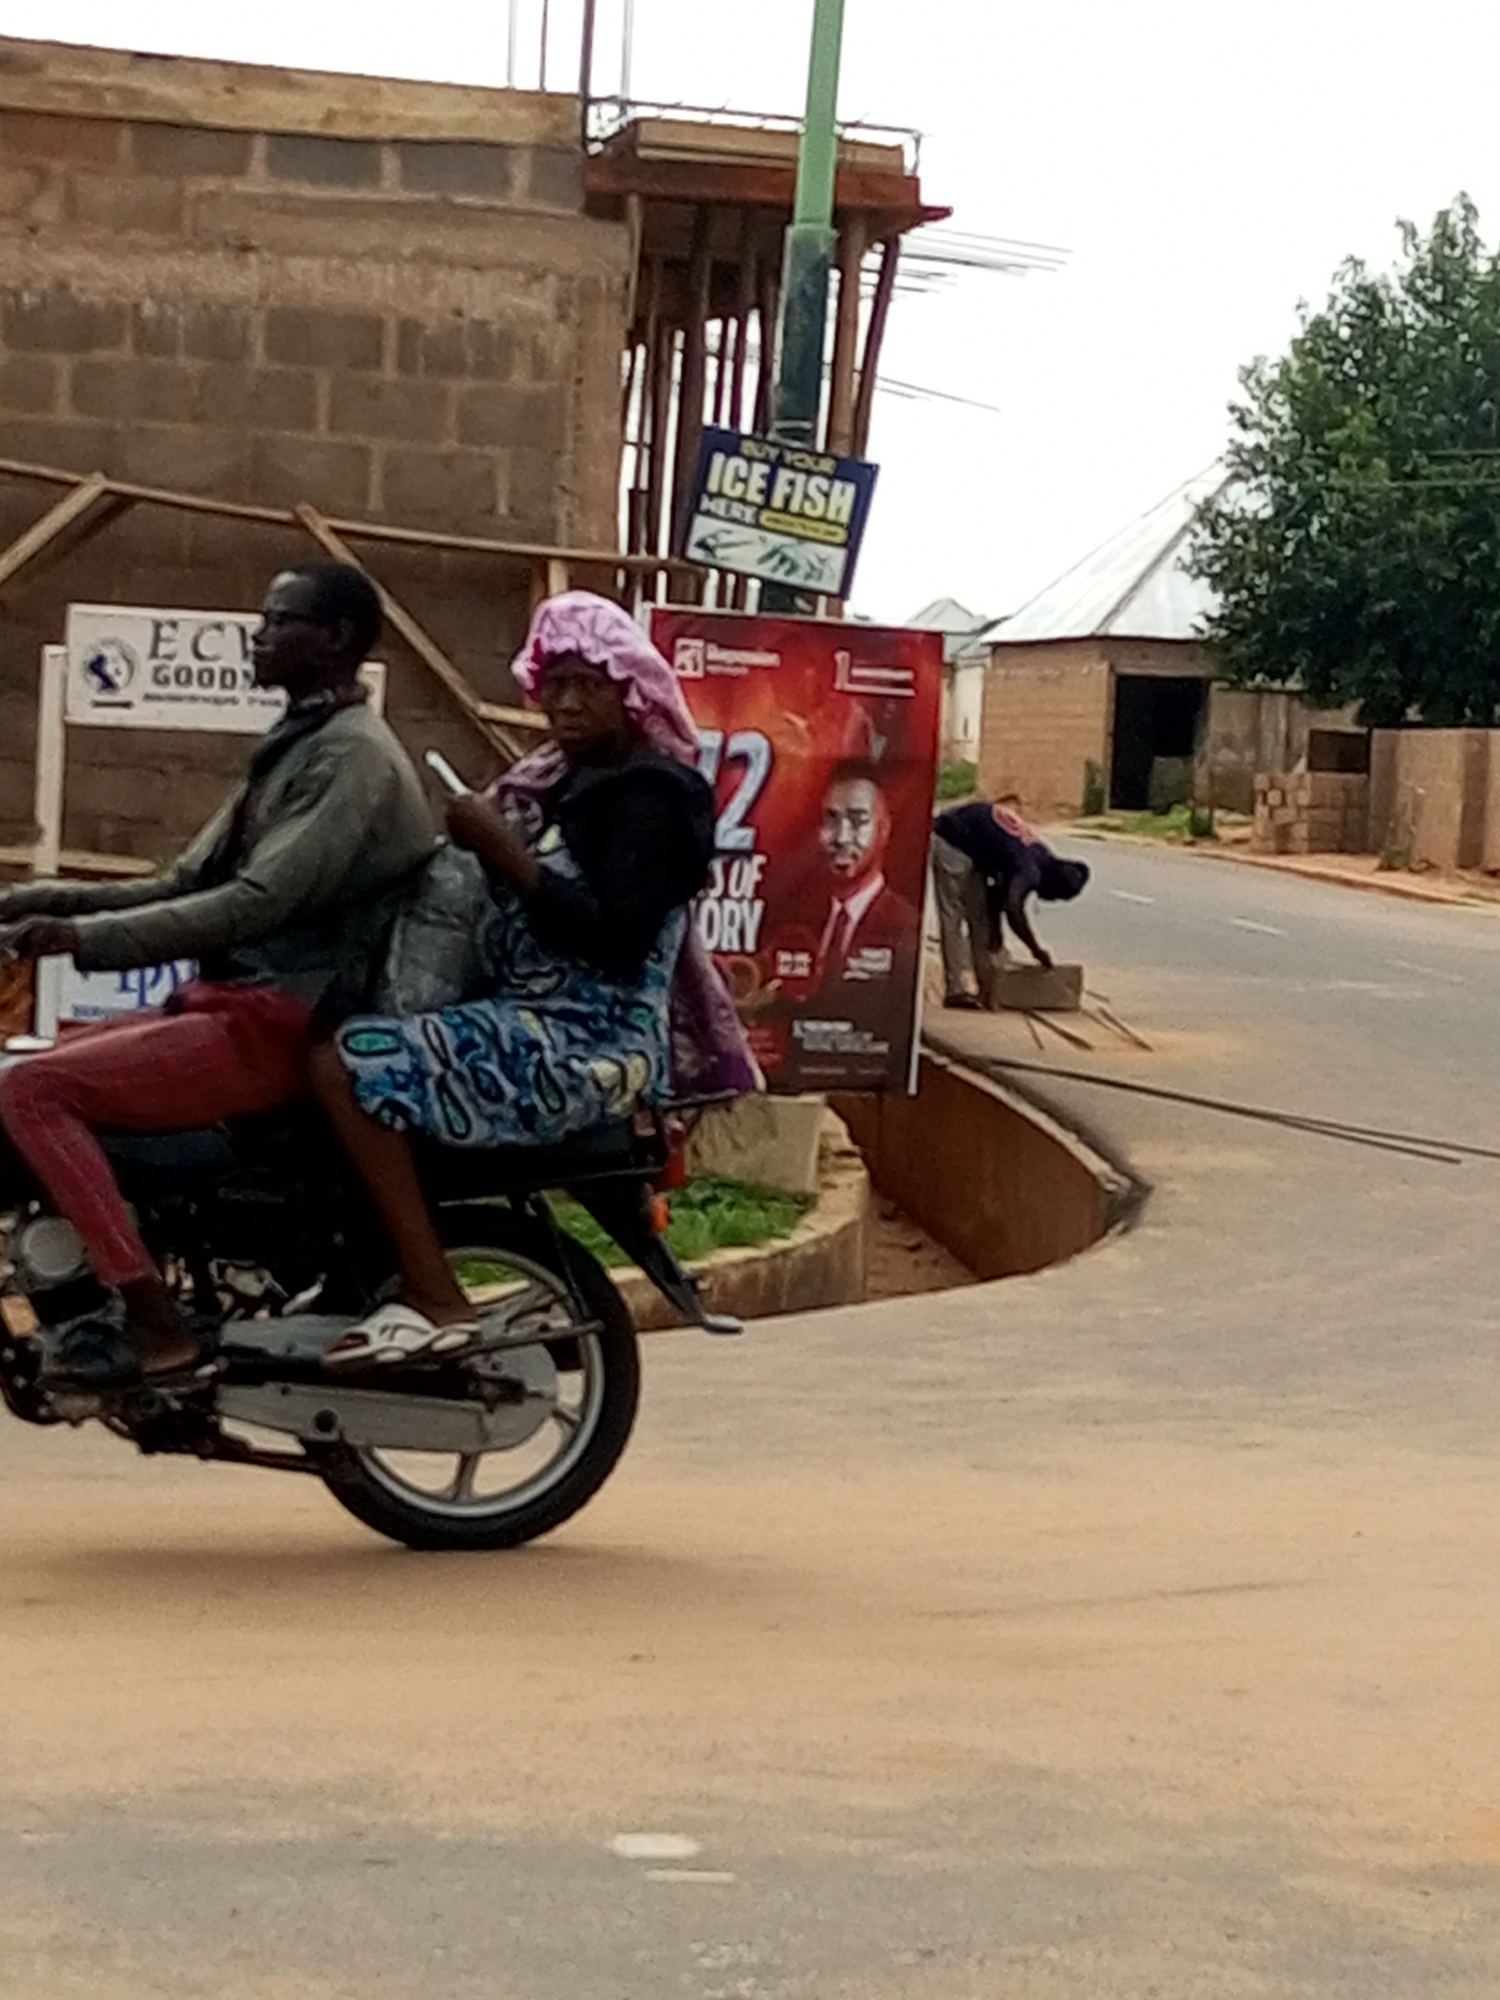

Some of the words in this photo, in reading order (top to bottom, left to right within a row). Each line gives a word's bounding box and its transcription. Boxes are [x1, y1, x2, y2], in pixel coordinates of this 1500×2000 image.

[706, 452, 770, 505] ICE
[770, 467, 857, 525] FISH
[700, 899, 765, 953] ORY
